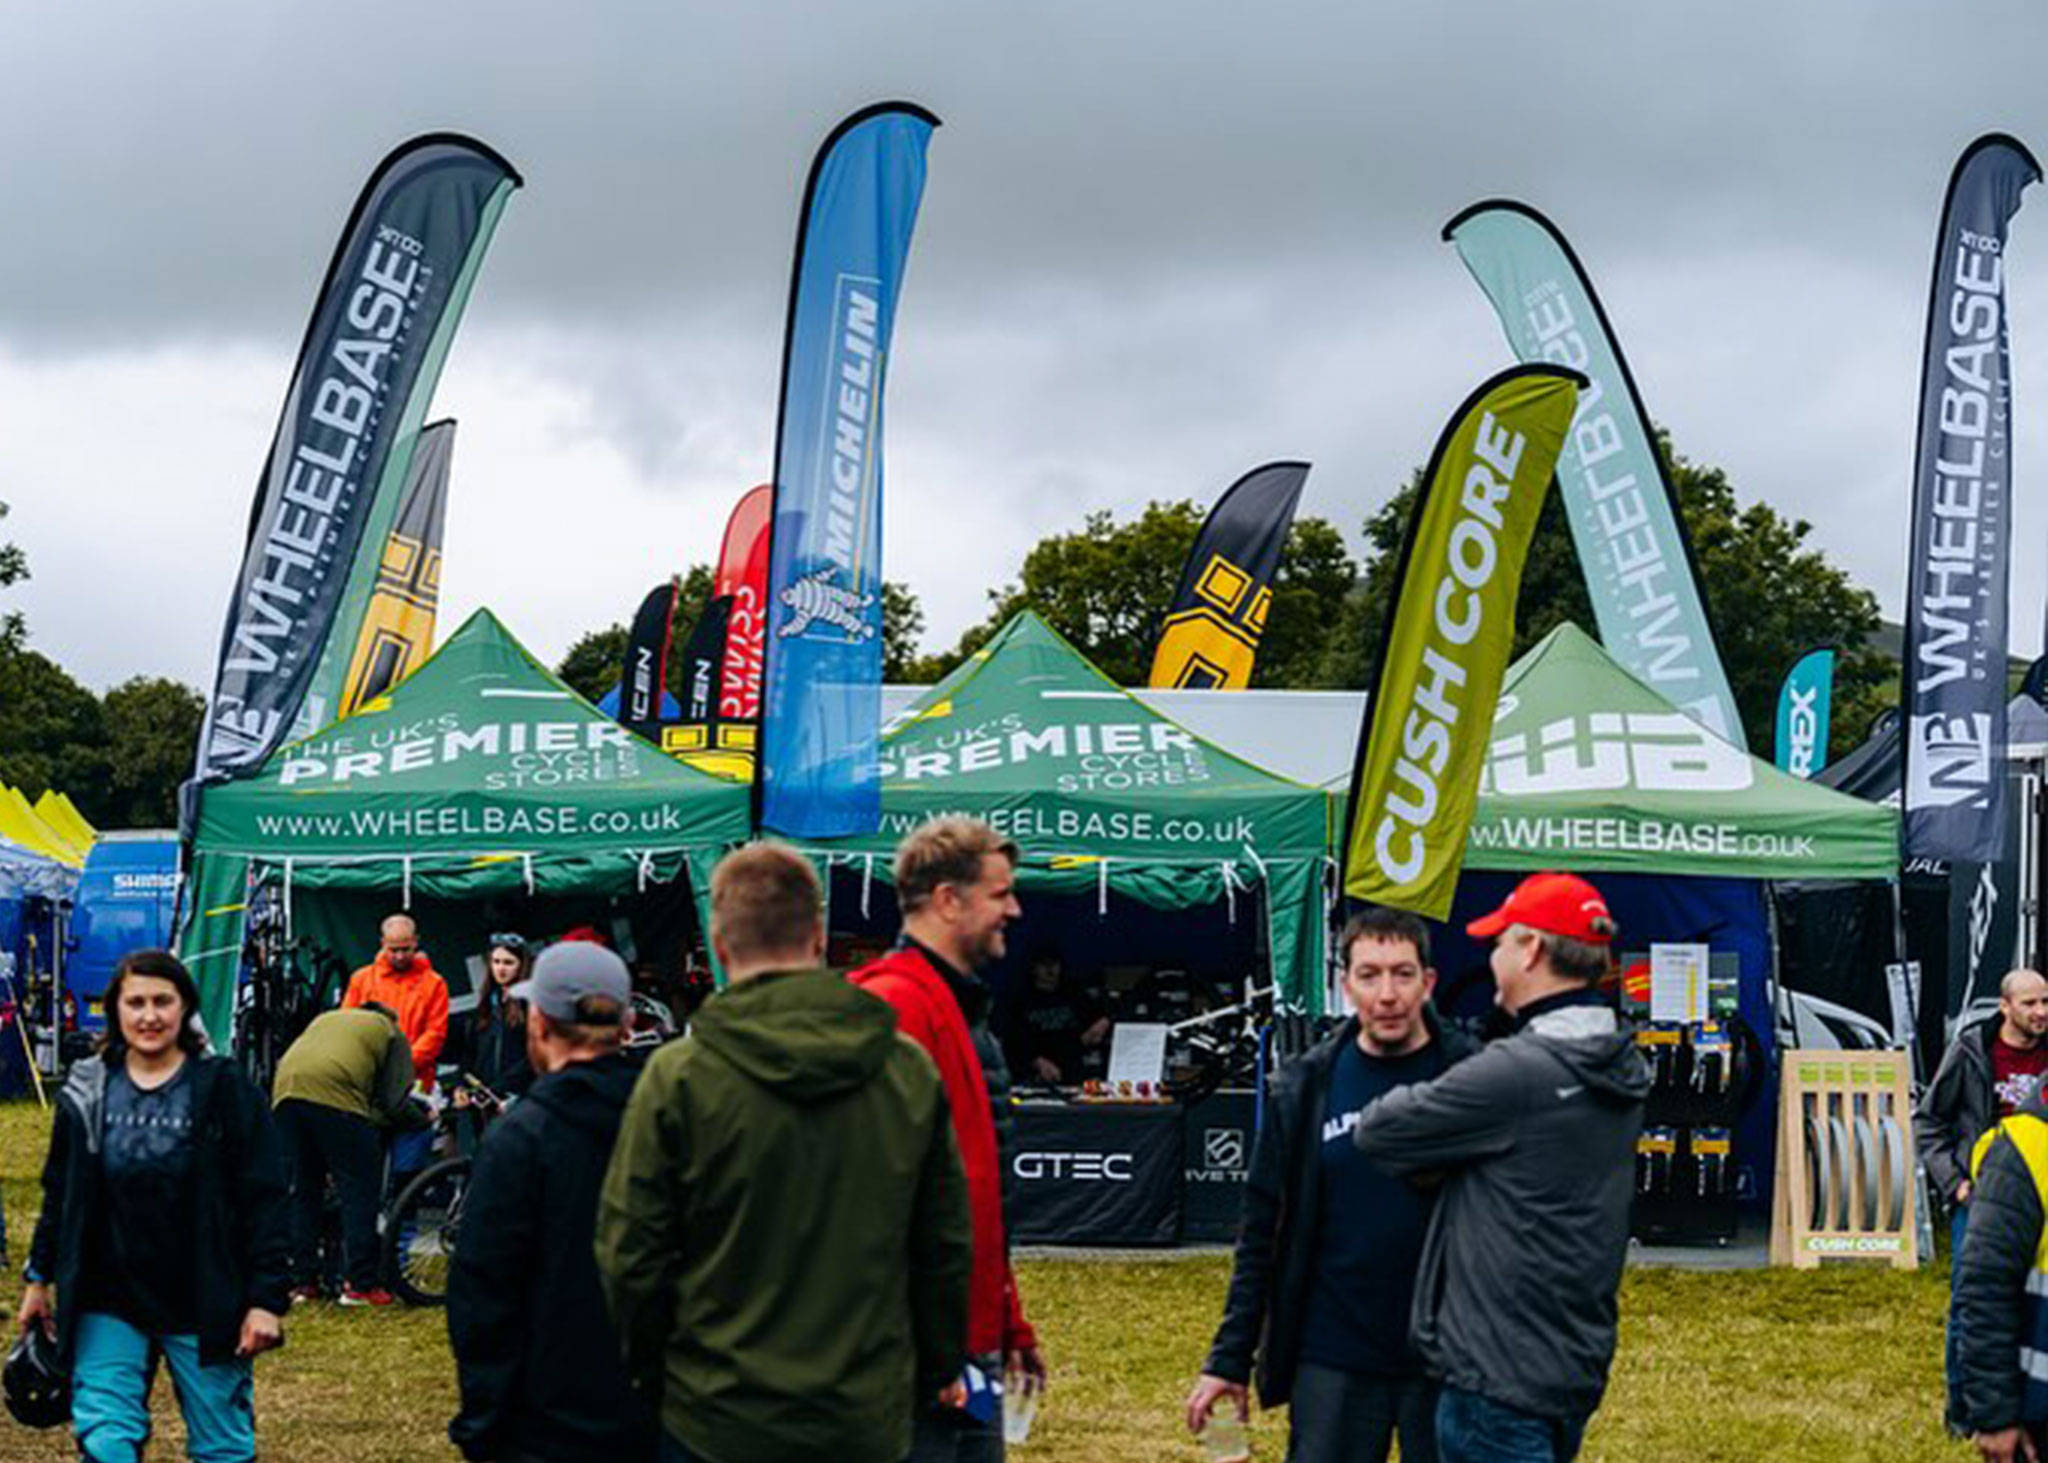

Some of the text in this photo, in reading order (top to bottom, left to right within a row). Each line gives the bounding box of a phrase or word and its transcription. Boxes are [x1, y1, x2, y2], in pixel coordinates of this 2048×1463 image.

[825, 290, 878, 568] MICHELIN
[222, 239, 420, 673] WHEELBASE
[1916, 246, 2003, 693] WHEELBASE
[1375, 413, 1527, 886] CUSH CORE
[371, 712, 459, 748] UK'S
[937, 713, 1023, 749] UK'S
[278, 720, 632, 785] PREMIER
[511, 745, 637, 771] CYCLE
[1081, 751, 1206, 773] CYCLE
[485, 763, 640, 791] STORES
[1056, 769, 1211, 794] STORES
[256, 803, 682, 837] www.WHEELBASE.co.uk
[1014, 1152, 1133, 1180] GTEC
